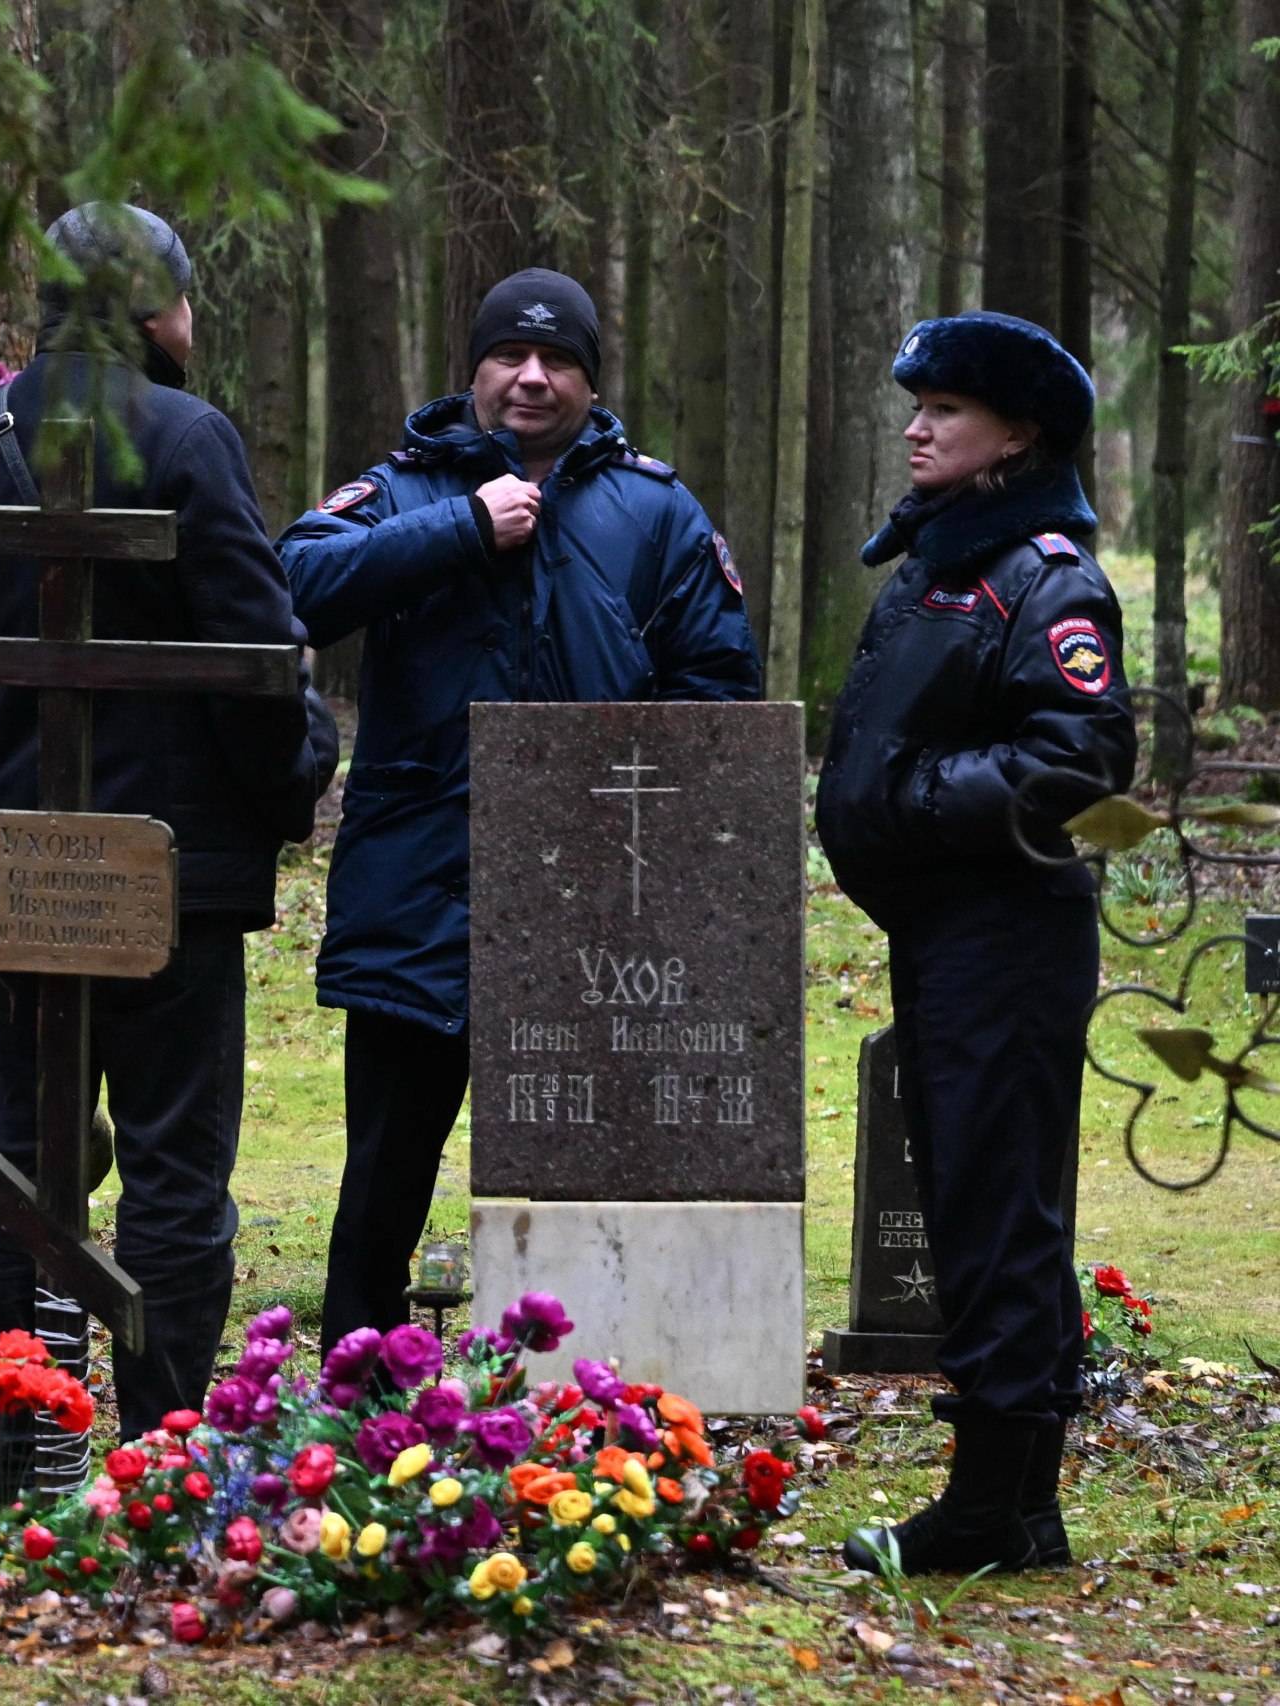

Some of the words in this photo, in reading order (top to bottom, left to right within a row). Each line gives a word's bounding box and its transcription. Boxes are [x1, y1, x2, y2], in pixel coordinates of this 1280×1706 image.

[1059, 633, 1098, 654] РОССИЯ
[1, 827, 107, 860] УХОВЫ
[576, 947, 686, 1006] УХОВ
[880, 1211, 924, 1228] АРЕС
[879, 1231, 929, 1248] РАССТ
